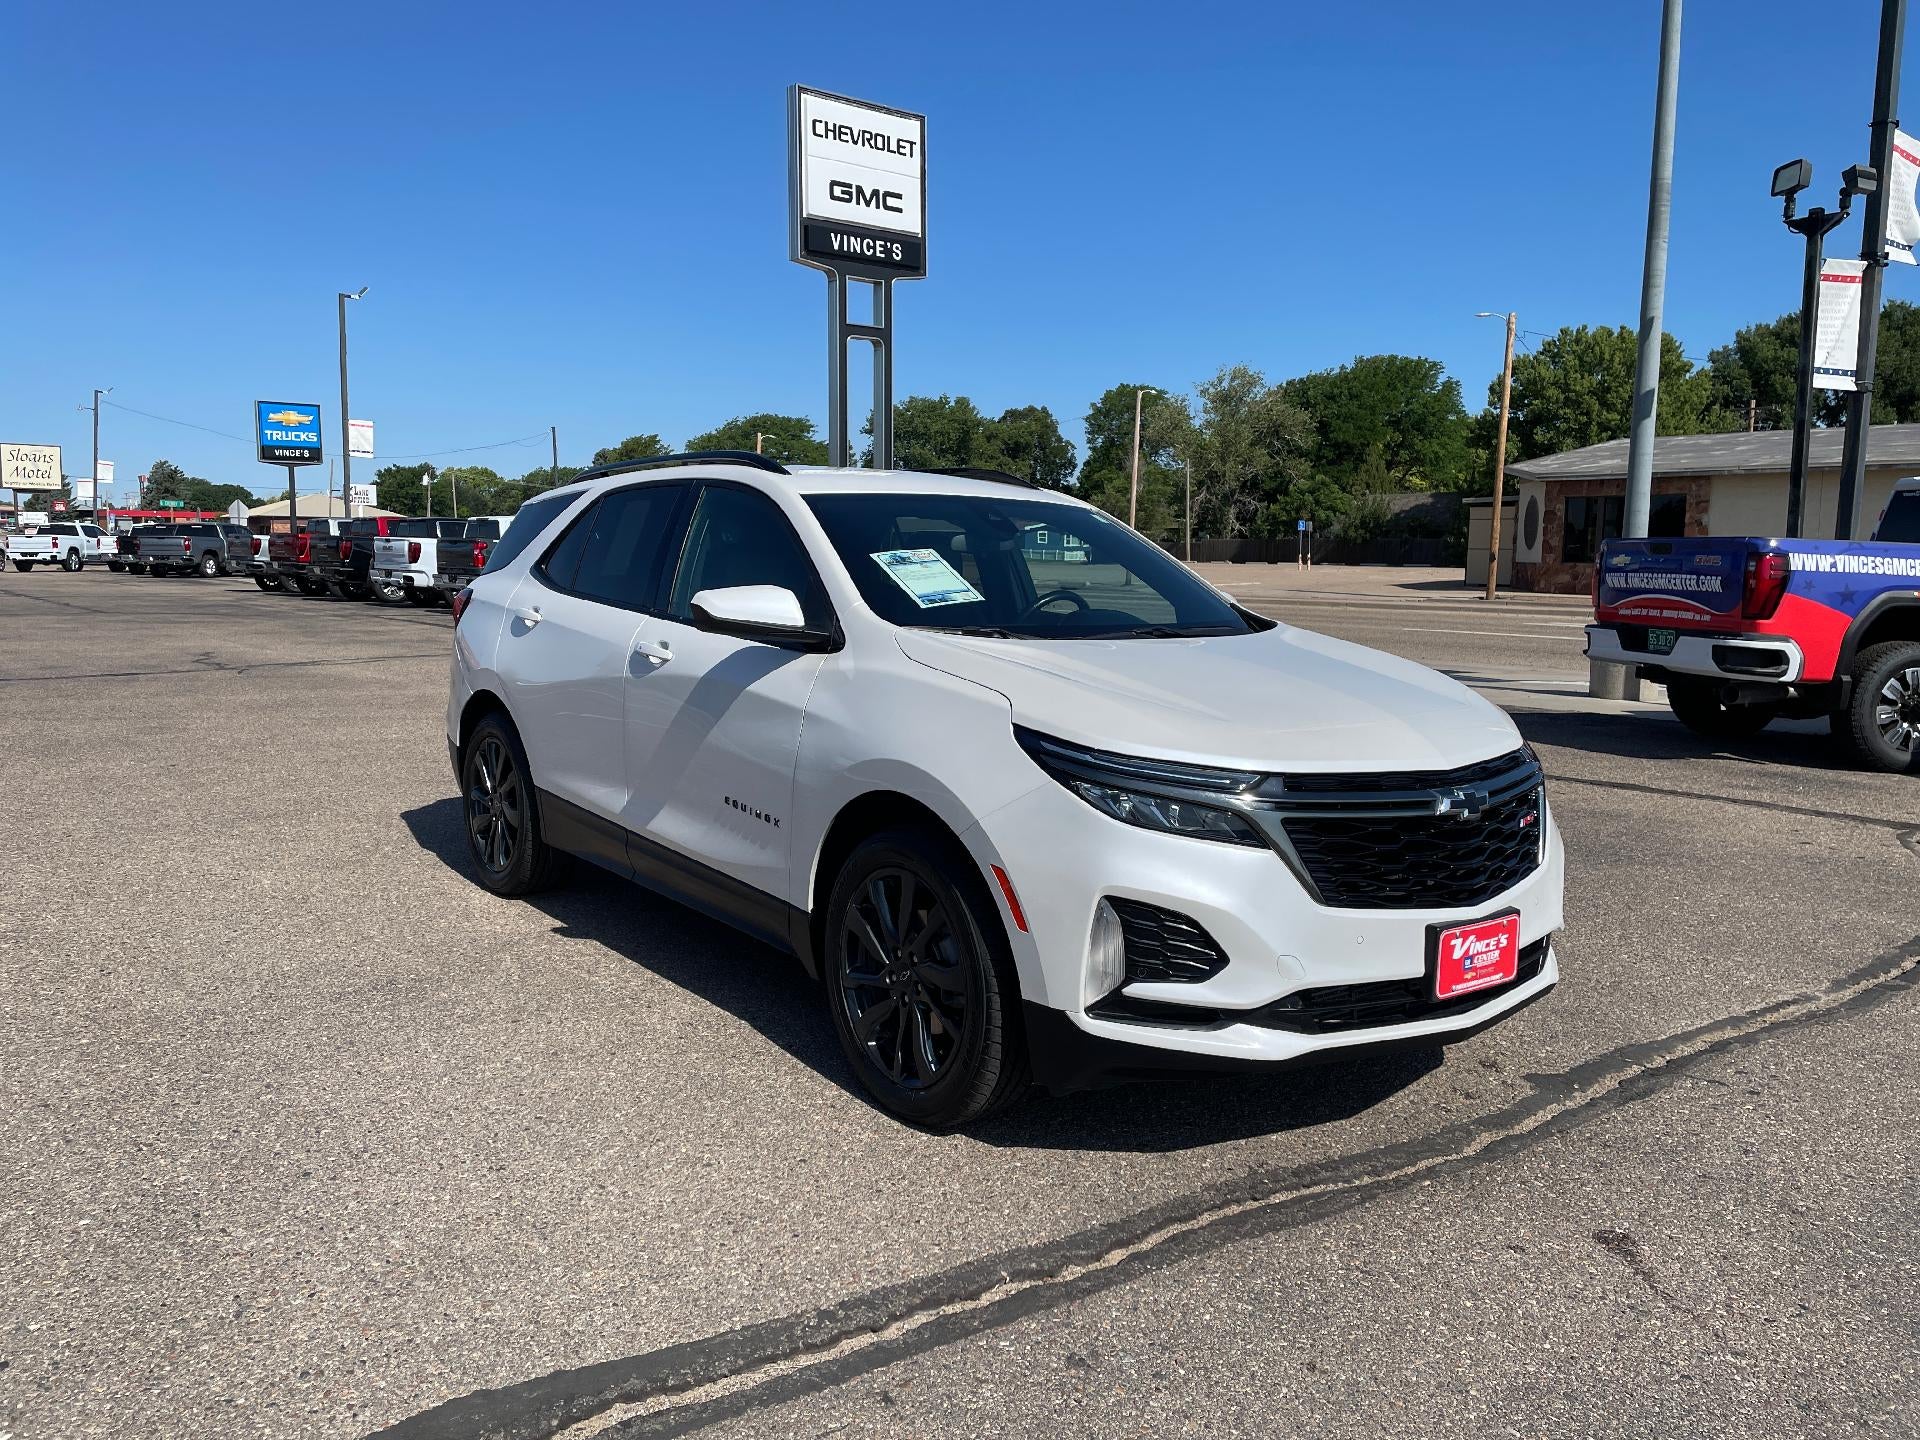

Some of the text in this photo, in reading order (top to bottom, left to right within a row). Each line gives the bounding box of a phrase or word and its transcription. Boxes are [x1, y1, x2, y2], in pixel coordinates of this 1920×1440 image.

[811, 118, 917, 158] CHEVROLET
[829, 180, 903, 214] GMC
[830, 232, 902, 260] VINCE'S
[264, 430, 318, 442] TRUCKS
[7, 448, 54, 464] Sloans
[274, 449, 310, 457] VINCE'S
[10, 465, 52, 479] Motel
[1694, 554, 1722, 566] GMC
[1605, 572, 1723, 593] WWW.VINCESGMCENTER.COM
[724, 796, 781, 828] EQUINOX
[1473, 949, 1500, 963] CENTER
